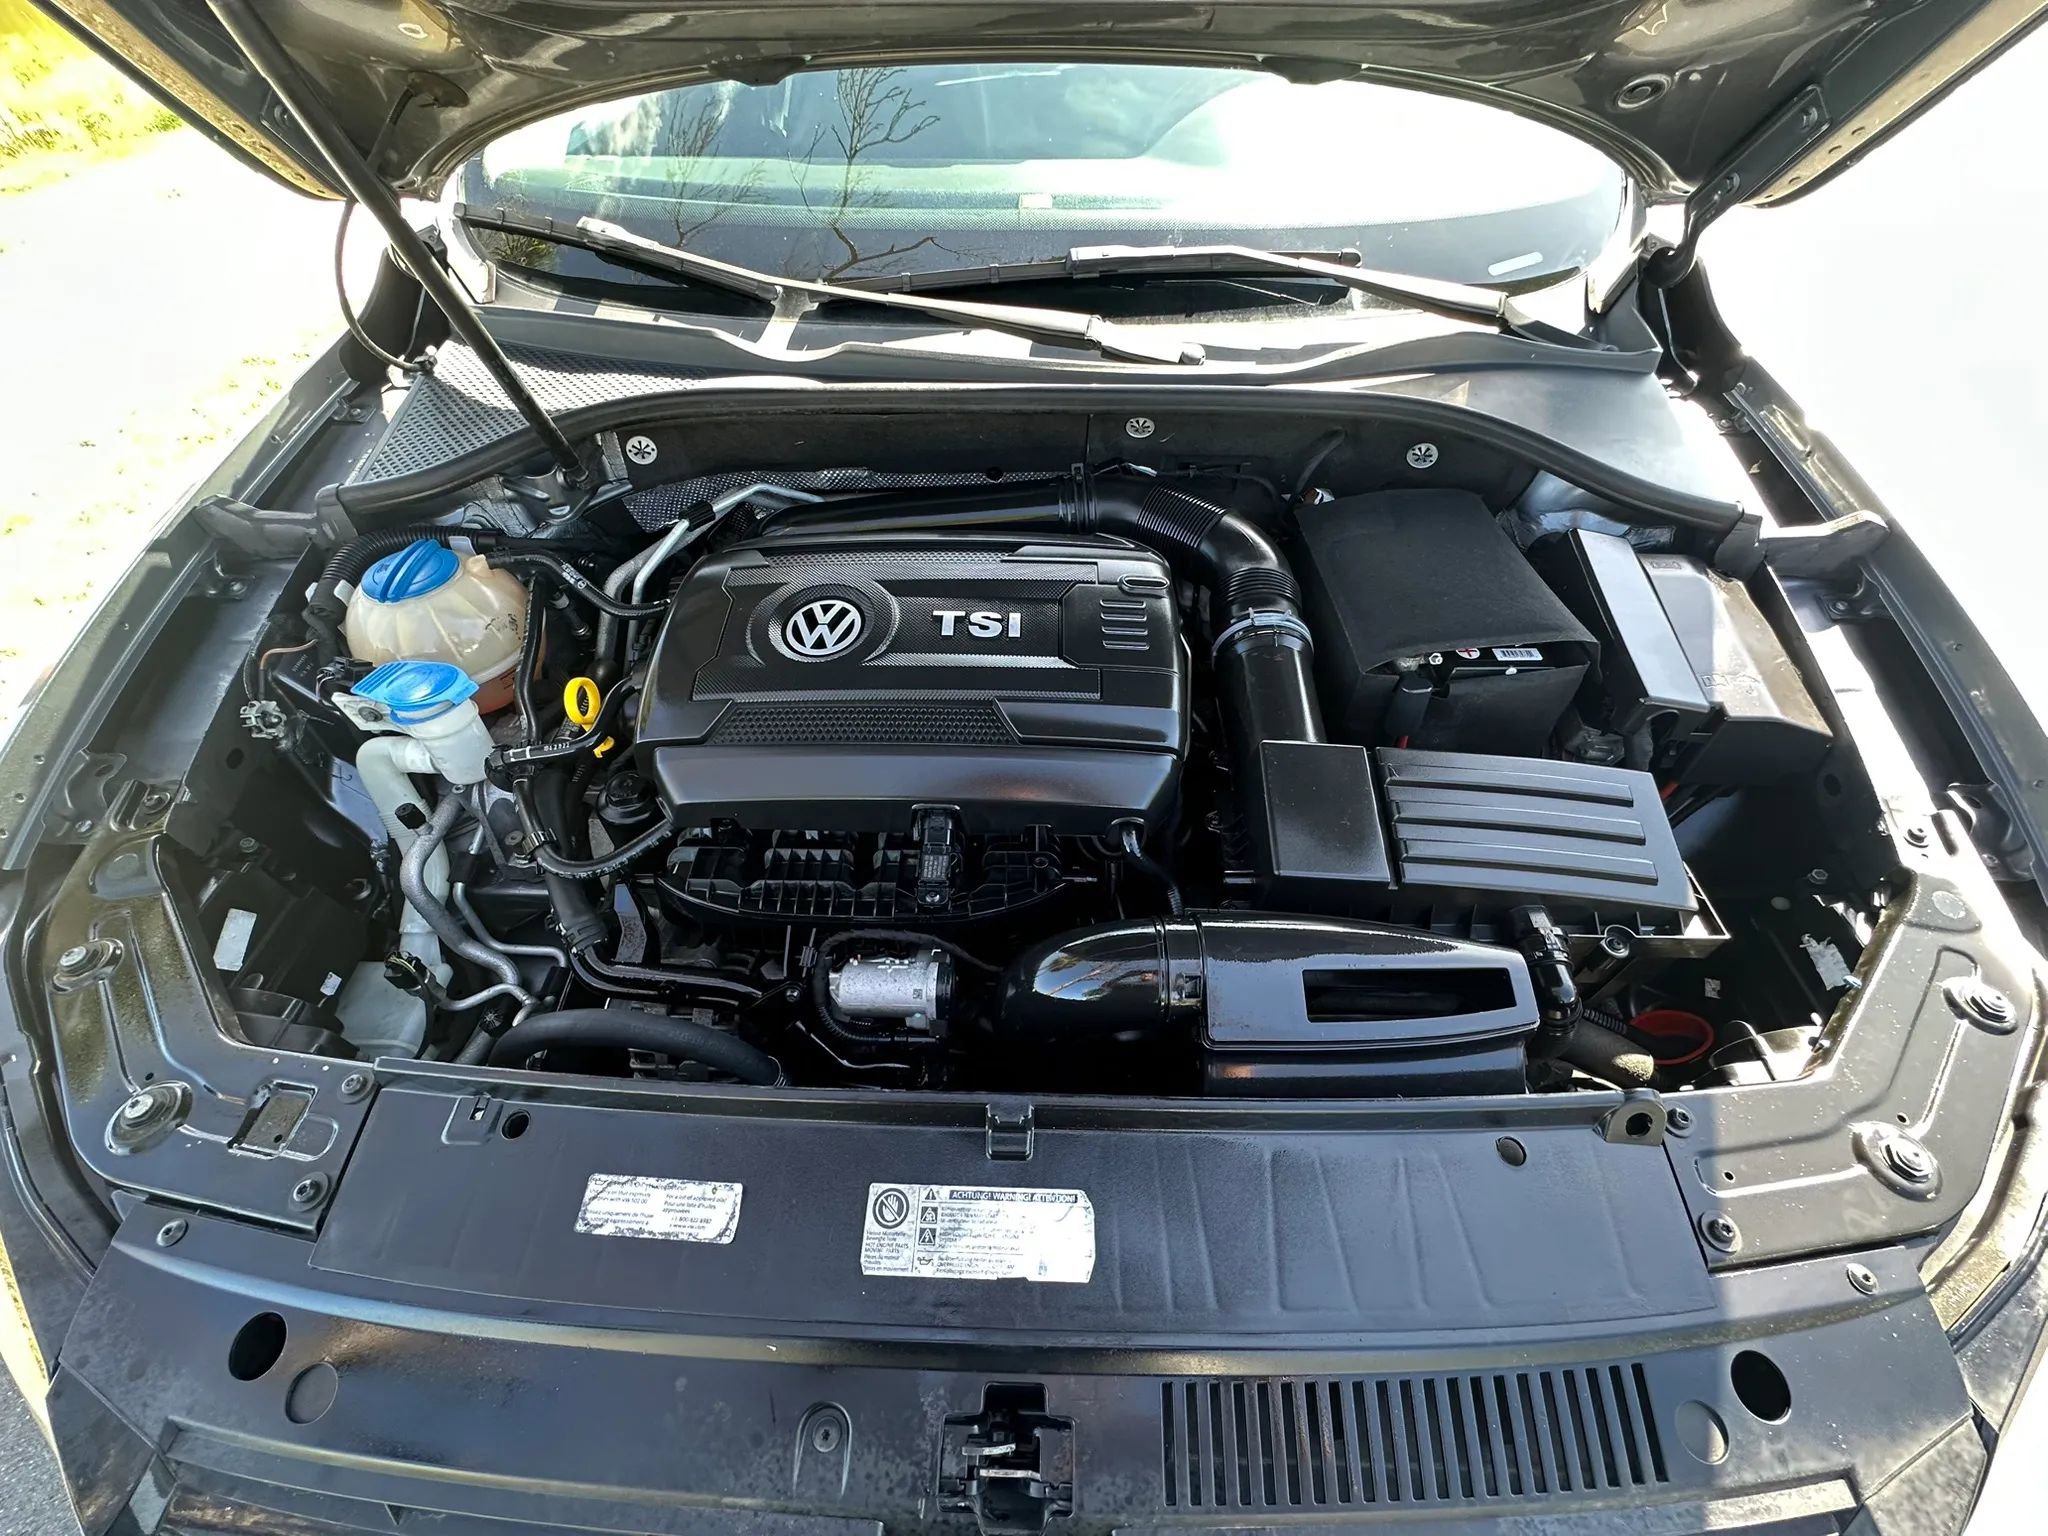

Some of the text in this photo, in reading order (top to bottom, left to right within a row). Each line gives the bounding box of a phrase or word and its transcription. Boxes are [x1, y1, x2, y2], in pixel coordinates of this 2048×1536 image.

[786, 599, 862, 656] VW
[932, 610, 1022, 638] TSI
[952, 1191, 991, 1200] ACHTUNG!
[993, 1192, 1031, 1202] WARNING!
